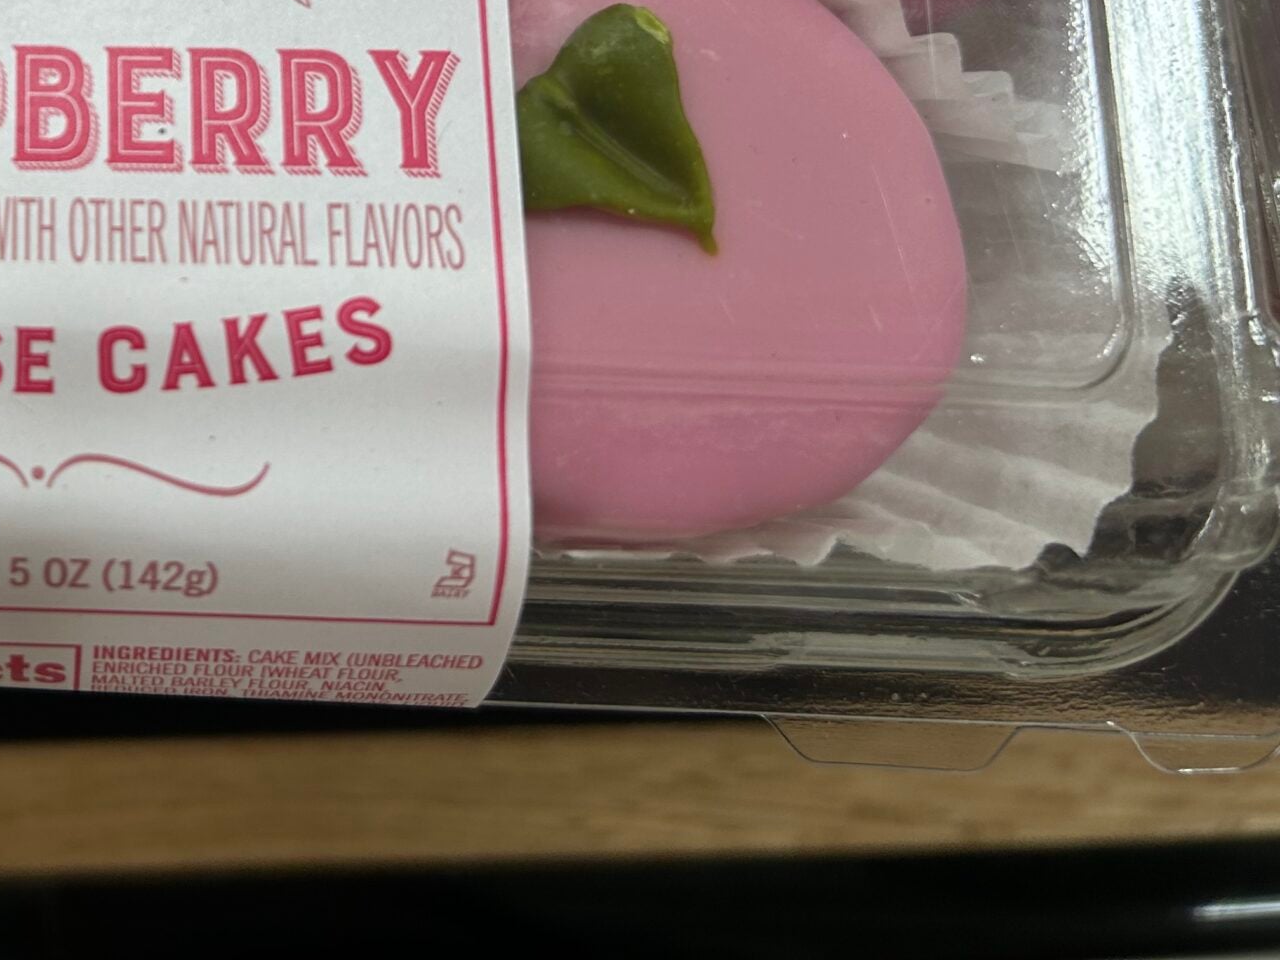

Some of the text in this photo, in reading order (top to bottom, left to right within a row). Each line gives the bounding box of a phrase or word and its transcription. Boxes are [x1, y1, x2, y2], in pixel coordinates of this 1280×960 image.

[68, 198, 167, 265] OTHER
[178, 199, 319, 268] NATURAL
[329, 201, 467, 271] FLAVORS
[97, 295, 394, 395] CAKES
[9, 556, 31, 587] 5
[43, 557, 91, 588] OZ
[102, 557, 219, 598] (142g)
[93, 645, 484, 669] INGREDIENTS: CAKE MIX (UNBLEACHED
[93, 661, 187, 676] ENRICHED
[193, 663, 253, 677] FLOUR
[337, 667, 402, 682] FLOUR,
[92, 674, 164, 687] MALTED
[170, 676, 242, 688] BARLEY
